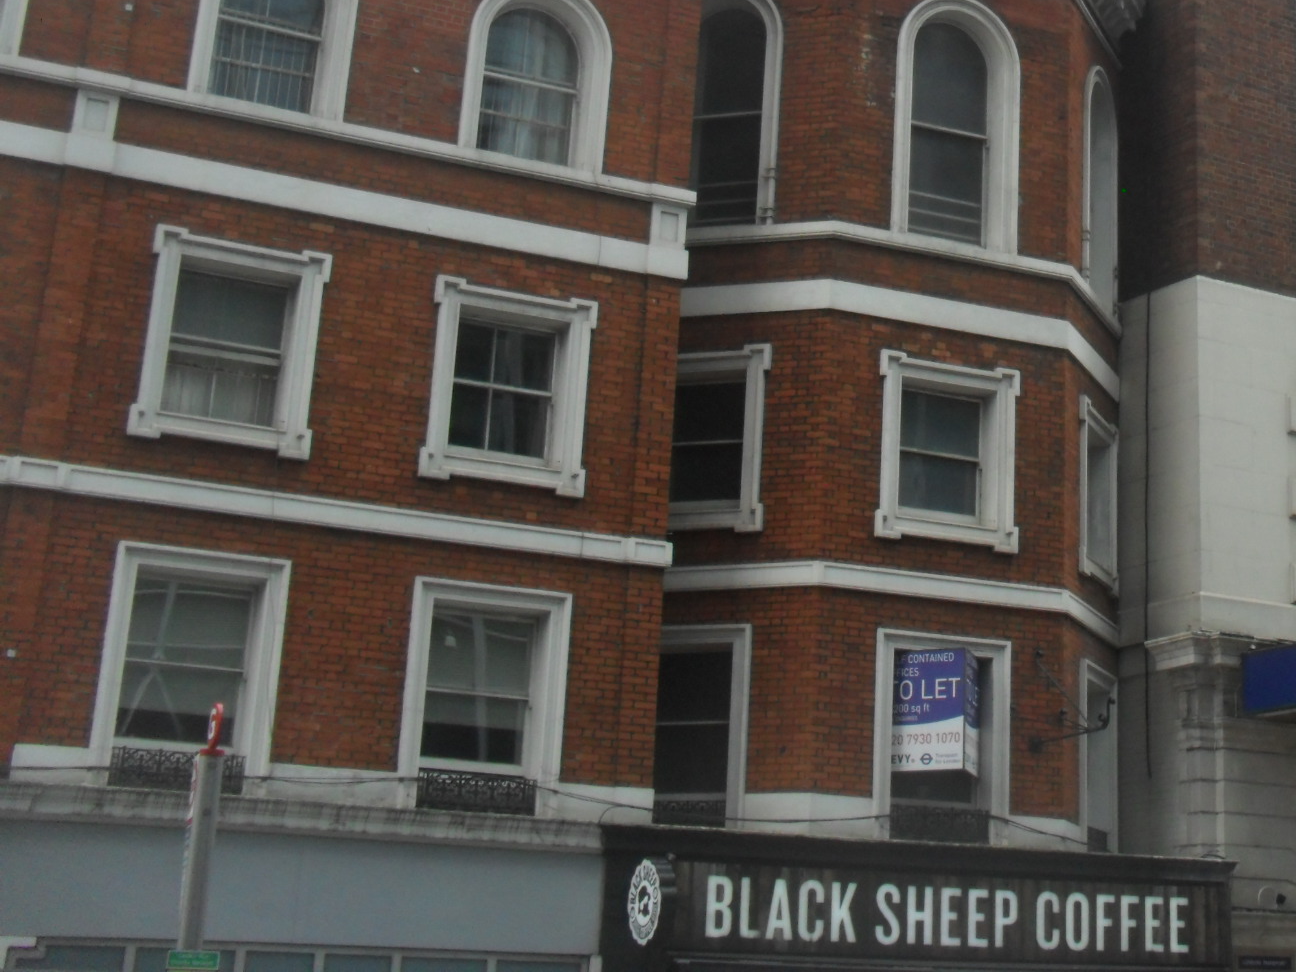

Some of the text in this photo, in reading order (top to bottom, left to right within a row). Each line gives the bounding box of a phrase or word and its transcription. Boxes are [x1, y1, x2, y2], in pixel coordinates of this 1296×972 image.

[907, 652, 955, 664] CONTAINED
[921, 677, 961, 700] LET
[911, 704, 921, 715] sq
[923, 703, 930, 713] ft
[906, 733, 932, 746] 7930
[935, 732, 961, 744] 1070
[705, 875, 858, 943] BLACK
[875, 883, 1018, 948] SHEEP
[1036, 891, 1190, 953] COFFEE
